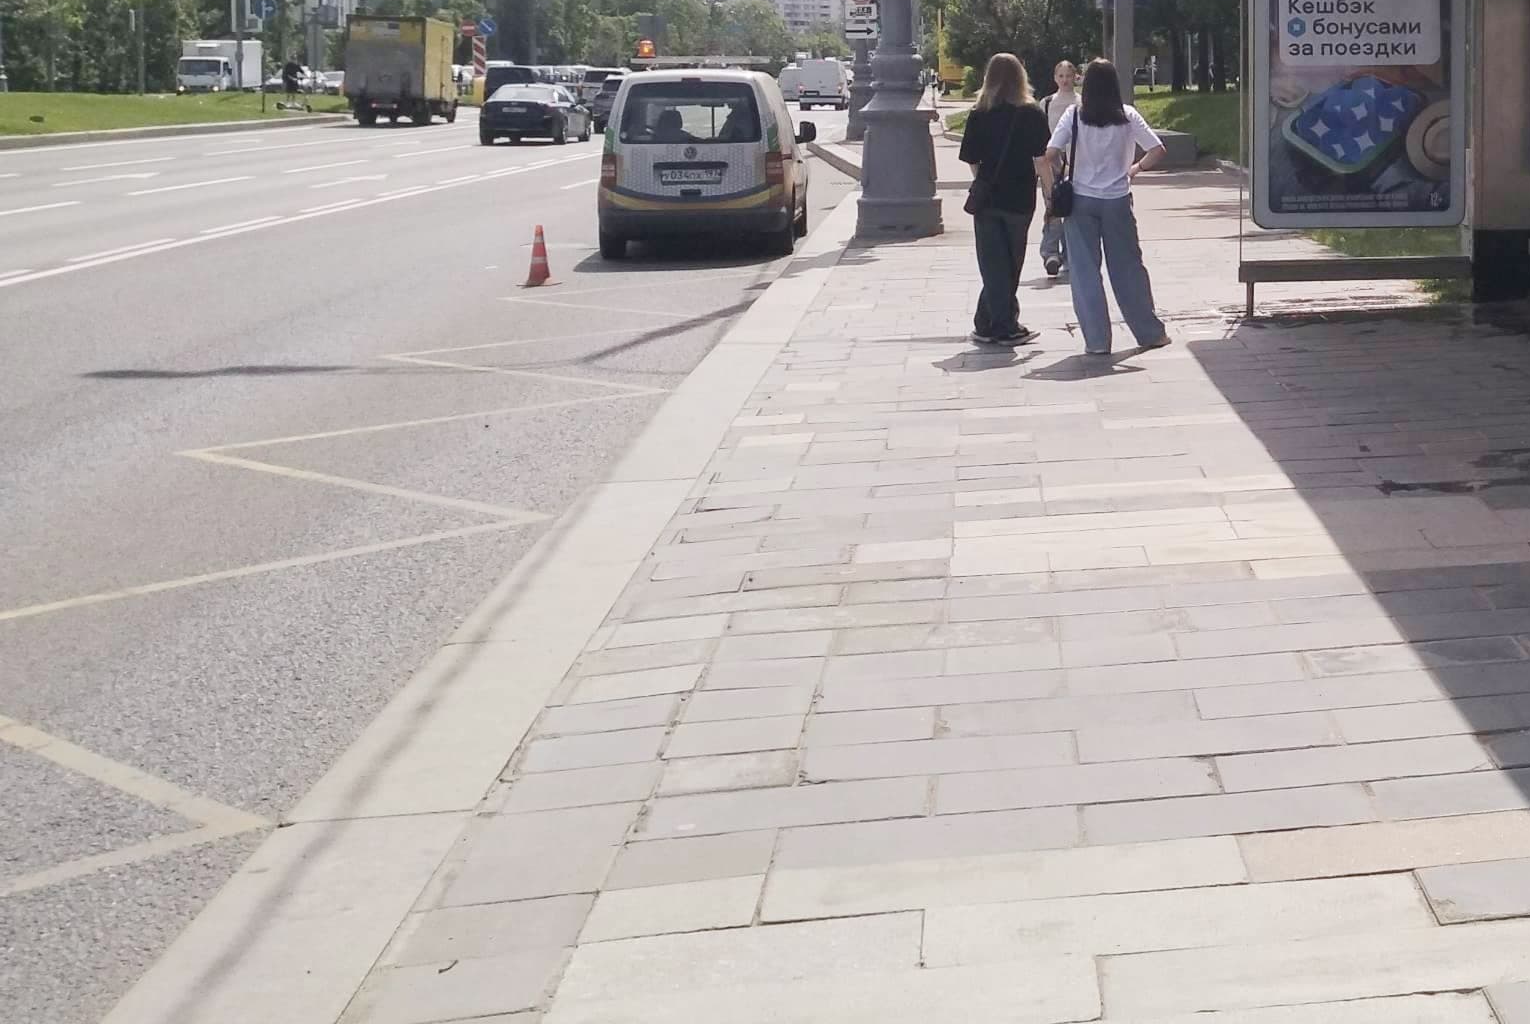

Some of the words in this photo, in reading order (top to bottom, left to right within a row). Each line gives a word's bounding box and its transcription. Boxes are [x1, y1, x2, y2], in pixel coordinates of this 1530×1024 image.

[1312, 18, 1421, 39] бонусами
[1288, 43, 1313, 56] за
[1320, 42, 1416, 58] поездки
